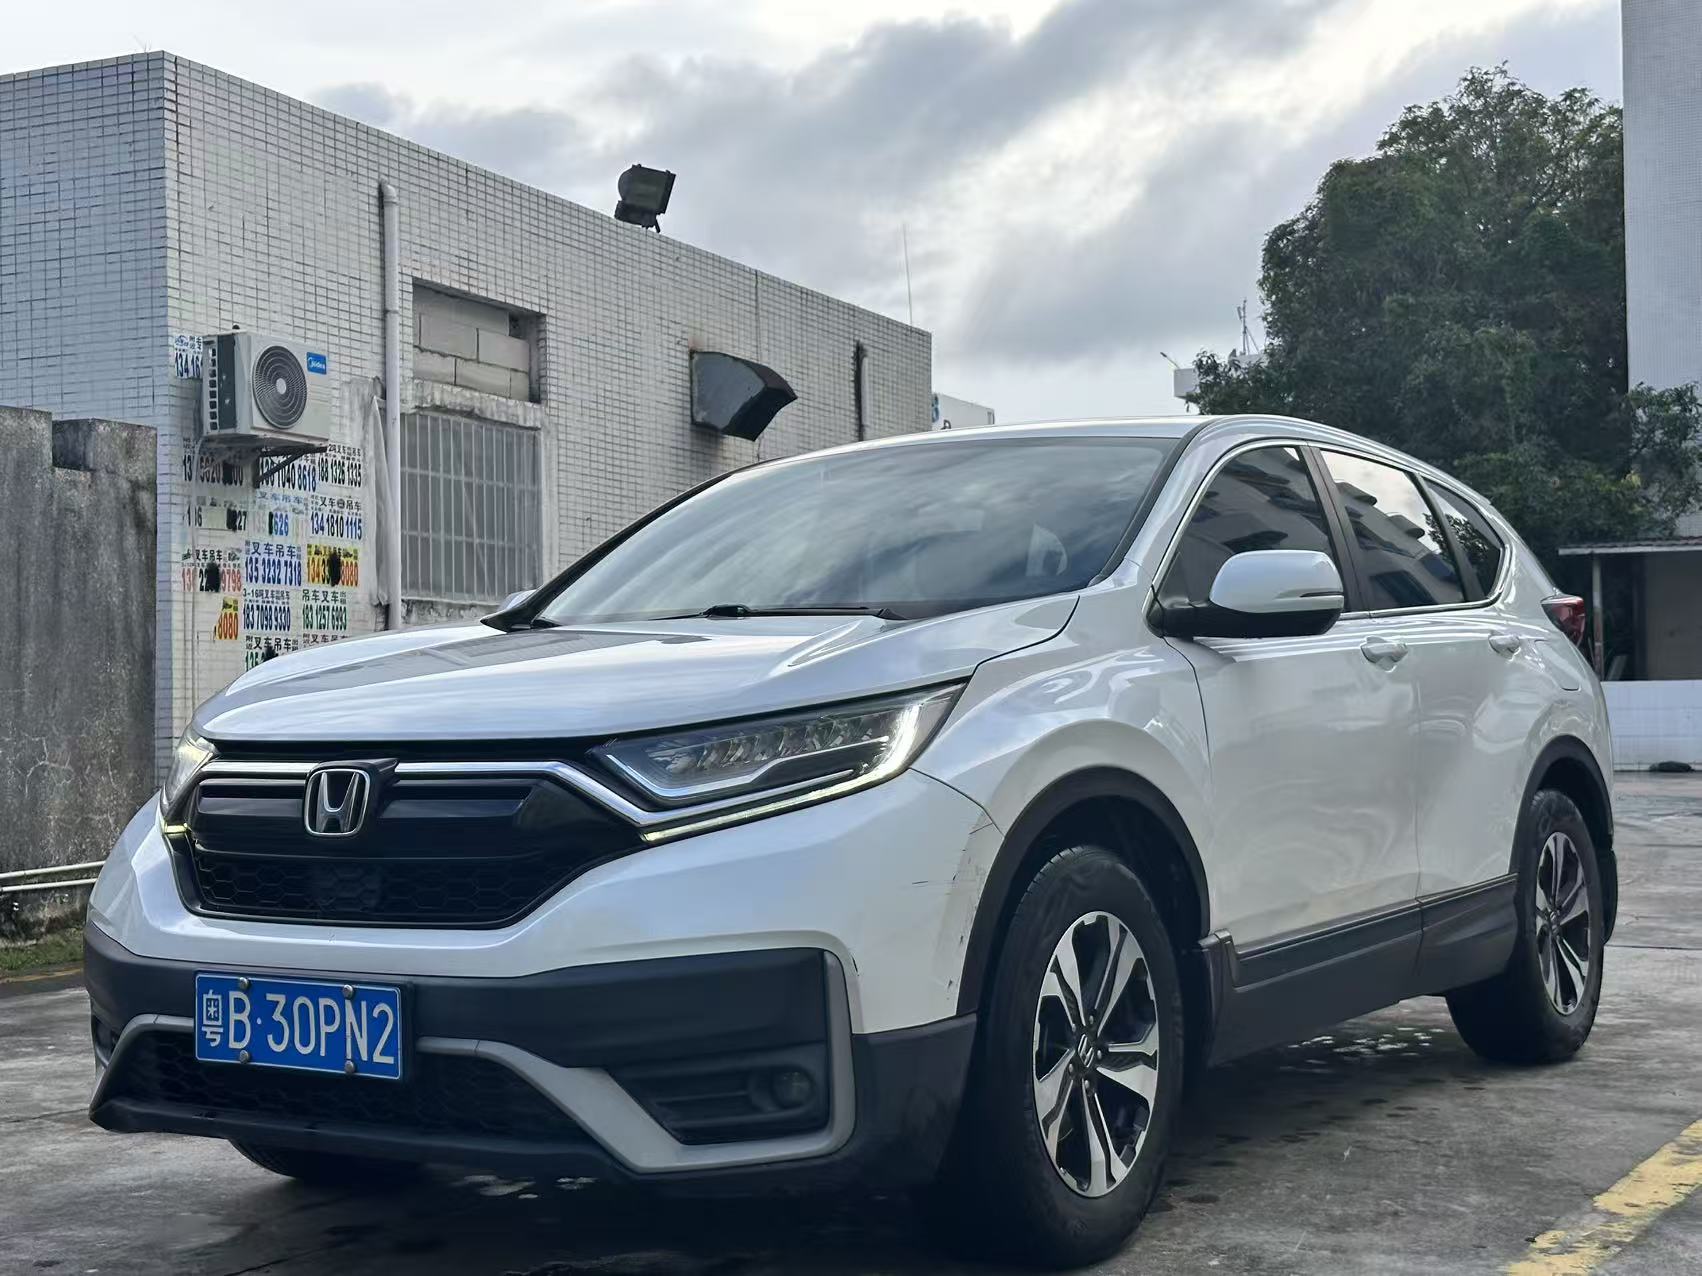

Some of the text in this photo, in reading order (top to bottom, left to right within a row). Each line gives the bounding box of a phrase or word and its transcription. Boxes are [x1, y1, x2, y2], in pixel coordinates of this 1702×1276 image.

[175, 352, 189, 377] 134
[298, 463, 316, 492] 8618
[318, 456, 329, 483] 188
[331, 458, 346, 485] 1326
[348, 461, 362, 488] 1335
[311, 511, 362, 540] 134 1810 1115
[251, 541, 296, 559] 叉车吊车
[245, 556, 302, 587] 135 3232 7318
[307, 556, 320, 583] 134
[302, 588, 339, 604] 吊车叉车
[243, 603, 254, 630] 183
[256, 604, 273, 631] 7098
[274, 605, 291, 632] 9330
[302, 603, 314, 630] 183
[316, 604, 330, 630] 1257
